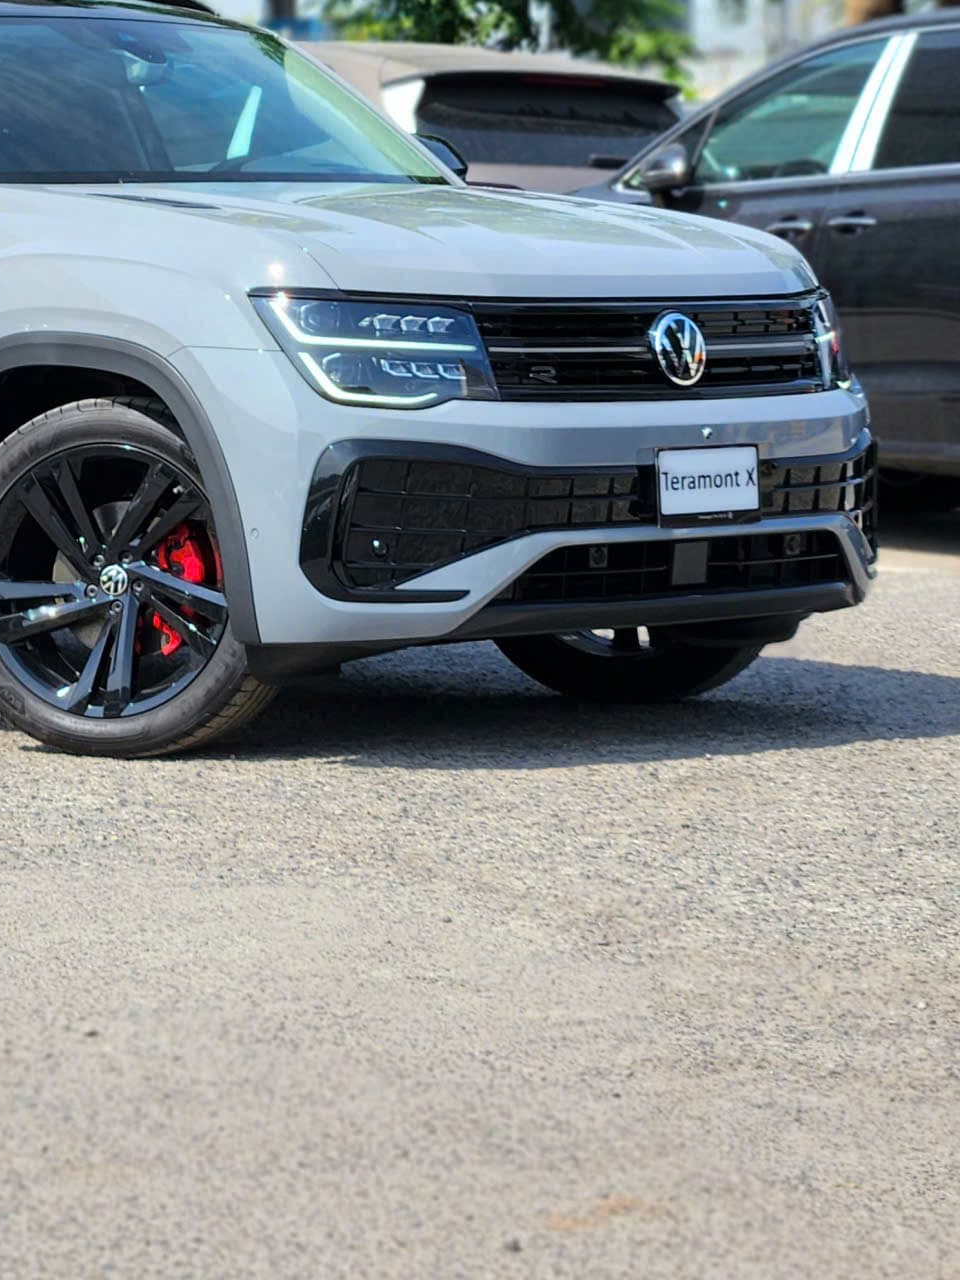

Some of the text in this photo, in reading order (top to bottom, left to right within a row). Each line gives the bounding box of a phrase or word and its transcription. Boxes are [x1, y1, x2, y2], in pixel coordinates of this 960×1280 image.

[652, 311, 706, 385] VW
[661, 467, 756, 491] Teramont X
